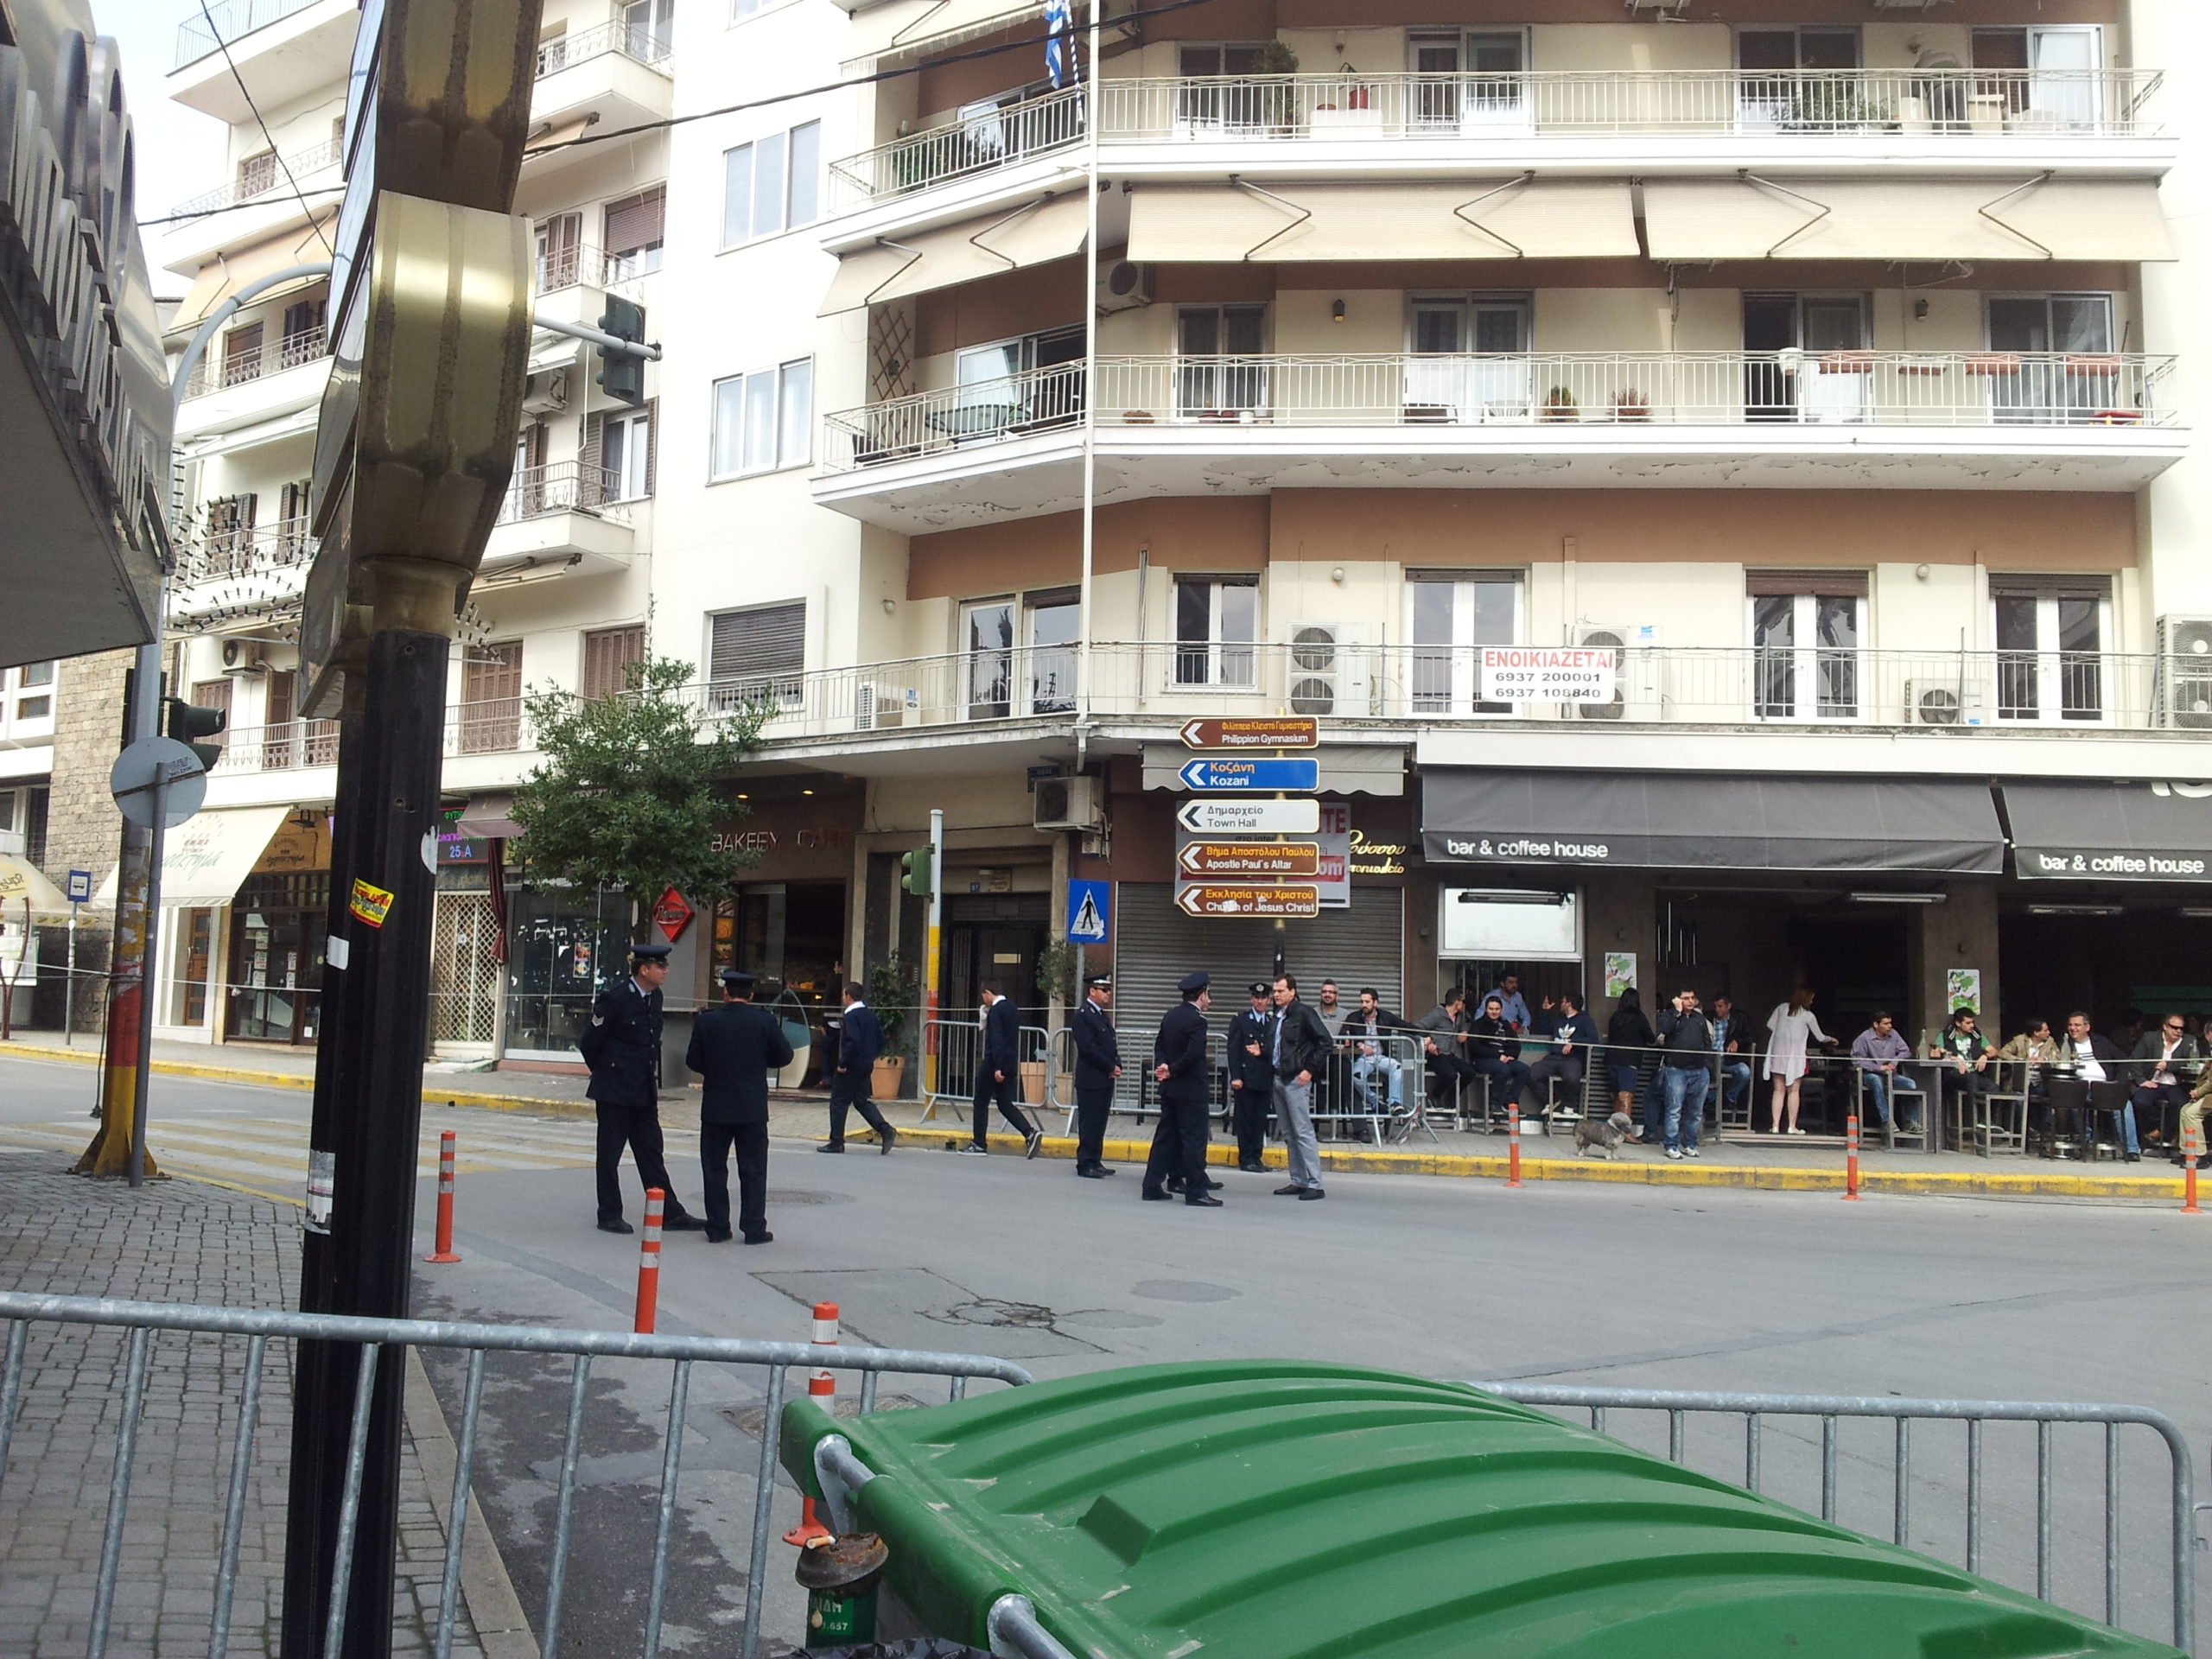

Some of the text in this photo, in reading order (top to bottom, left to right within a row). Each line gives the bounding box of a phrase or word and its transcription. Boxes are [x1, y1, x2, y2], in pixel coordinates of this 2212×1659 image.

[1485, 651, 1613, 668] ΕΝΟΙΚΙΑΖΕΤΑΙ
[1496, 672, 1600, 682] 6937 200001
[1496, 689, 1601, 698] 6937 108840
[1222, 734, 1308, 745] Philippion Gymnasium
[1211, 762, 1255, 774] Κοζάνη
[1211, 776, 1249, 786] Kozani
[1207, 805, 1263, 815] Δημαρχείο
[1207, 818, 1256, 827] Town Hall
[1206, 847, 1230, 857] Βήμα
[1230, 847, 1280, 857] Αποστόλου
[1282, 847, 1314, 856] Παύλου
[1446, 839, 1608, 858] bar & coffee house
[1206, 859, 1240, 869] Apostle
[1271, 860, 1293, 869] Altar
[2039, 854, 2205, 874] bar & coffee house
[1205, 889, 1252, 900] Εκκλησία
[1274, 890, 1313, 900] Χριστού
[1243, 902, 1253, 912] of
[1255, 903, 1283, 912] Jesus
[1286, 903, 1314, 912] Christ
